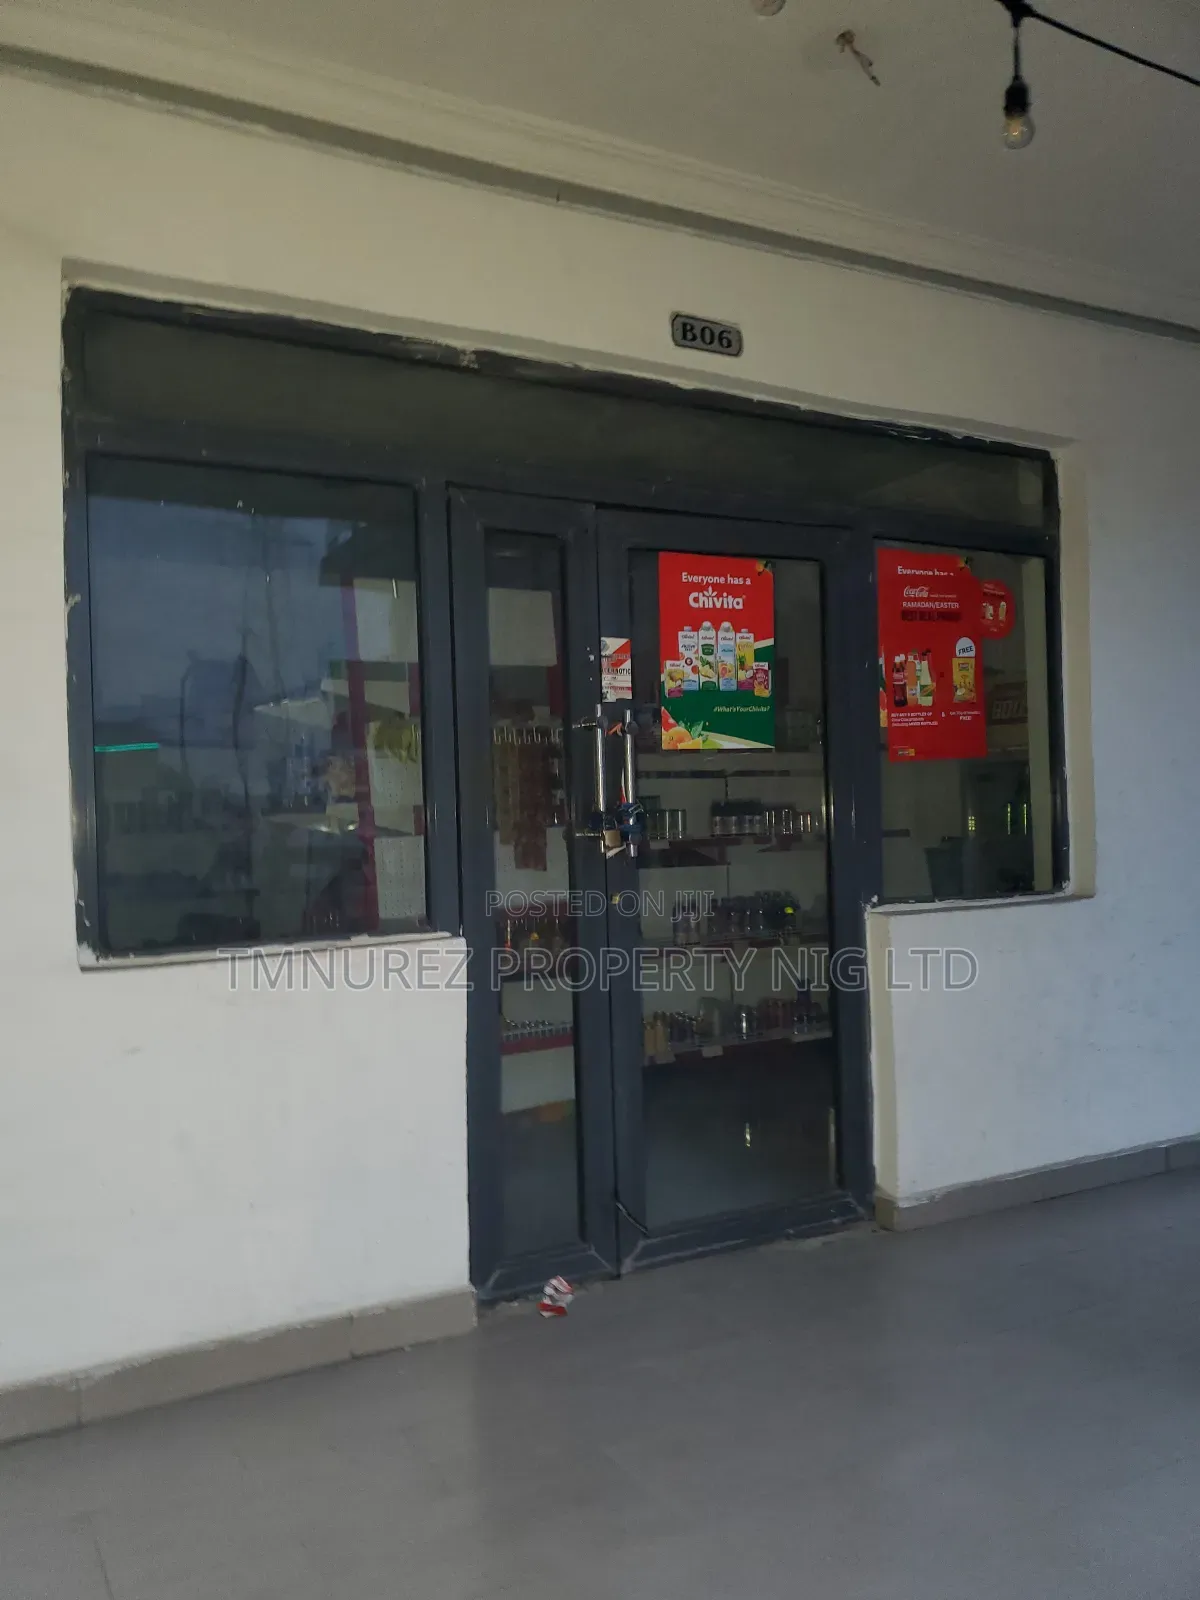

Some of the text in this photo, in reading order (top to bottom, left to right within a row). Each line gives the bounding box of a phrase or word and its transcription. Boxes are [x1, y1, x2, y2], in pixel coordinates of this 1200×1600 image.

[681, 321, 733, 349] B06
[681, 571, 726, 585] Everyone
[727, 574, 744, 585] has
[688, 585, 744, 610] Chivita
[902, 601, 960, 609] RAMADAN/EASTER
[958, 645, 974, 656] FREE
